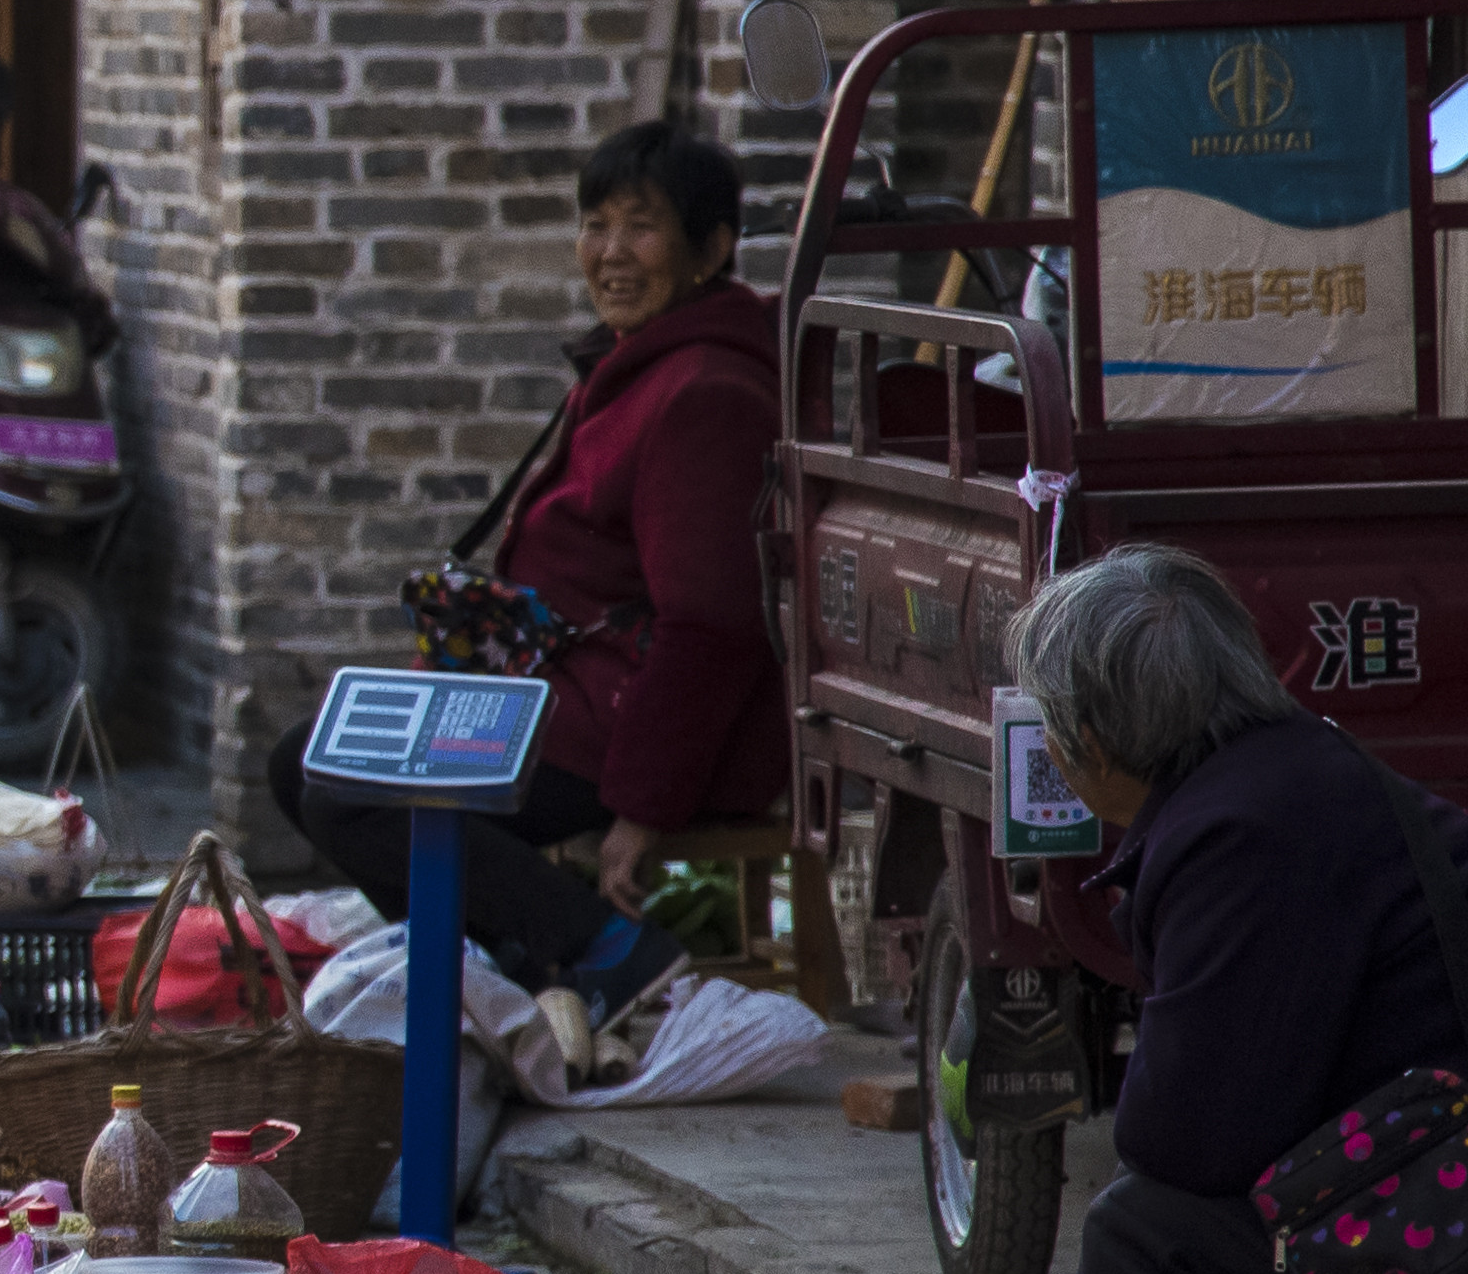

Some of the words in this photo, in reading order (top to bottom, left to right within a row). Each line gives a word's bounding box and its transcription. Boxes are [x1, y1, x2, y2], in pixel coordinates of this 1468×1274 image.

[1143, 263, 1367, 326] 淮海车辆
[1309, 597, 1421, 691] 淮
